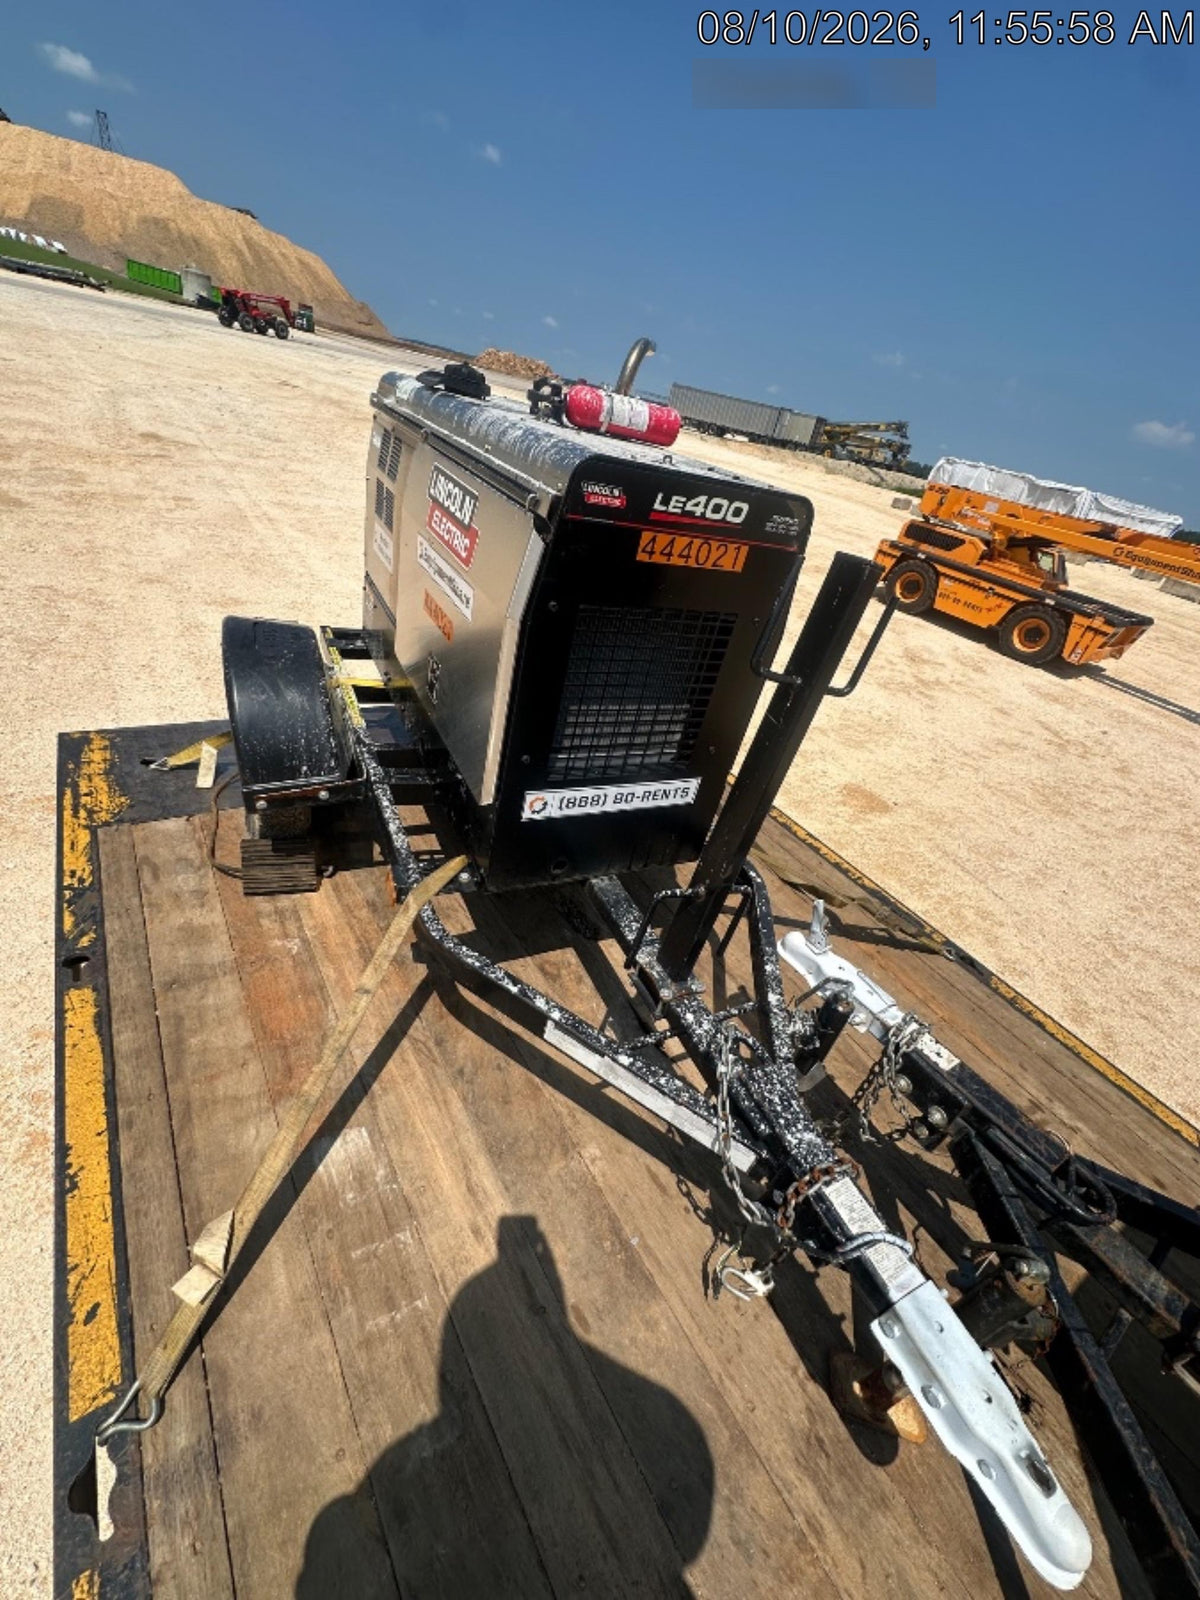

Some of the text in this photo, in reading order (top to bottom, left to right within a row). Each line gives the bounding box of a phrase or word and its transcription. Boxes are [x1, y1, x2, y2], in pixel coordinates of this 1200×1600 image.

[429, 471, 475, 526] LINCOLN
[653, 492, 749, 524] LE400
[431, 510, 471, 559] ELECTRIC
[641, 534, 742, 570] 444021
